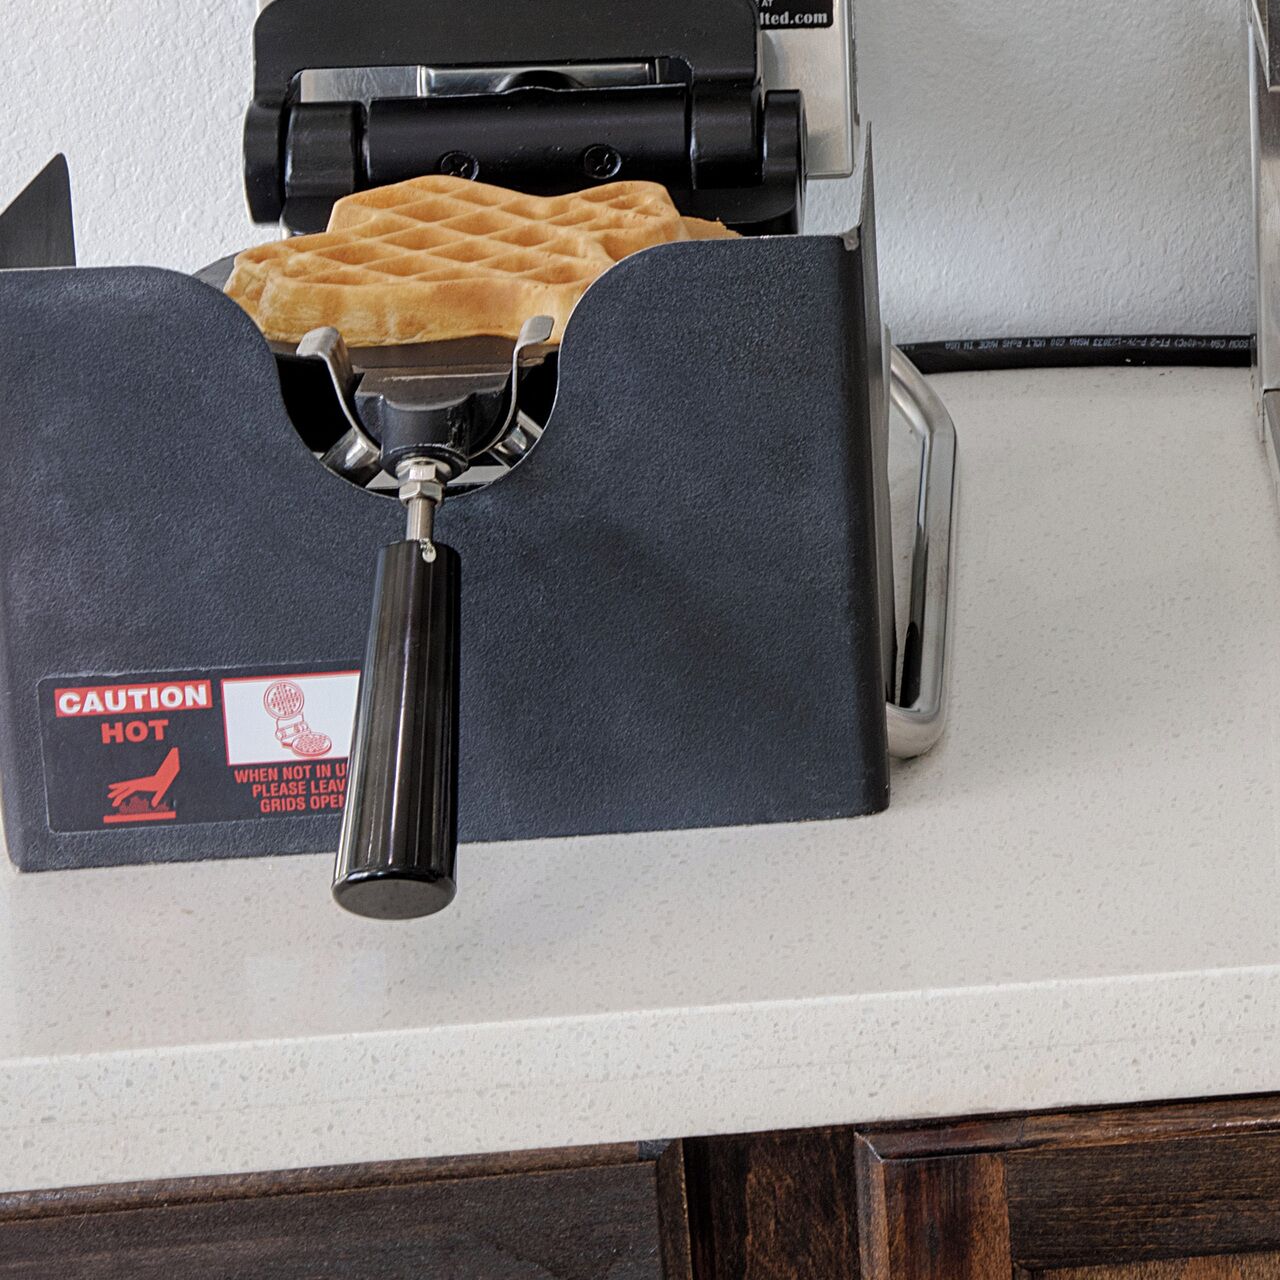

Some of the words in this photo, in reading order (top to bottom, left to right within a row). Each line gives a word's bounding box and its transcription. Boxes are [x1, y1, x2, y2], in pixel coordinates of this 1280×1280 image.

[58, 684, 208, 715] CAUTION
[101, 719, 169, 744] HOT
[234, 768, 278, 783] WHEN
[282, 765, 312, 781] NOT
[315, 764, 331, 778] IN
[252, 781, 306, 798] PLEASE
[310, 778, 346, 794] LEAV
[260, 797, 306, 813] GRIDS
